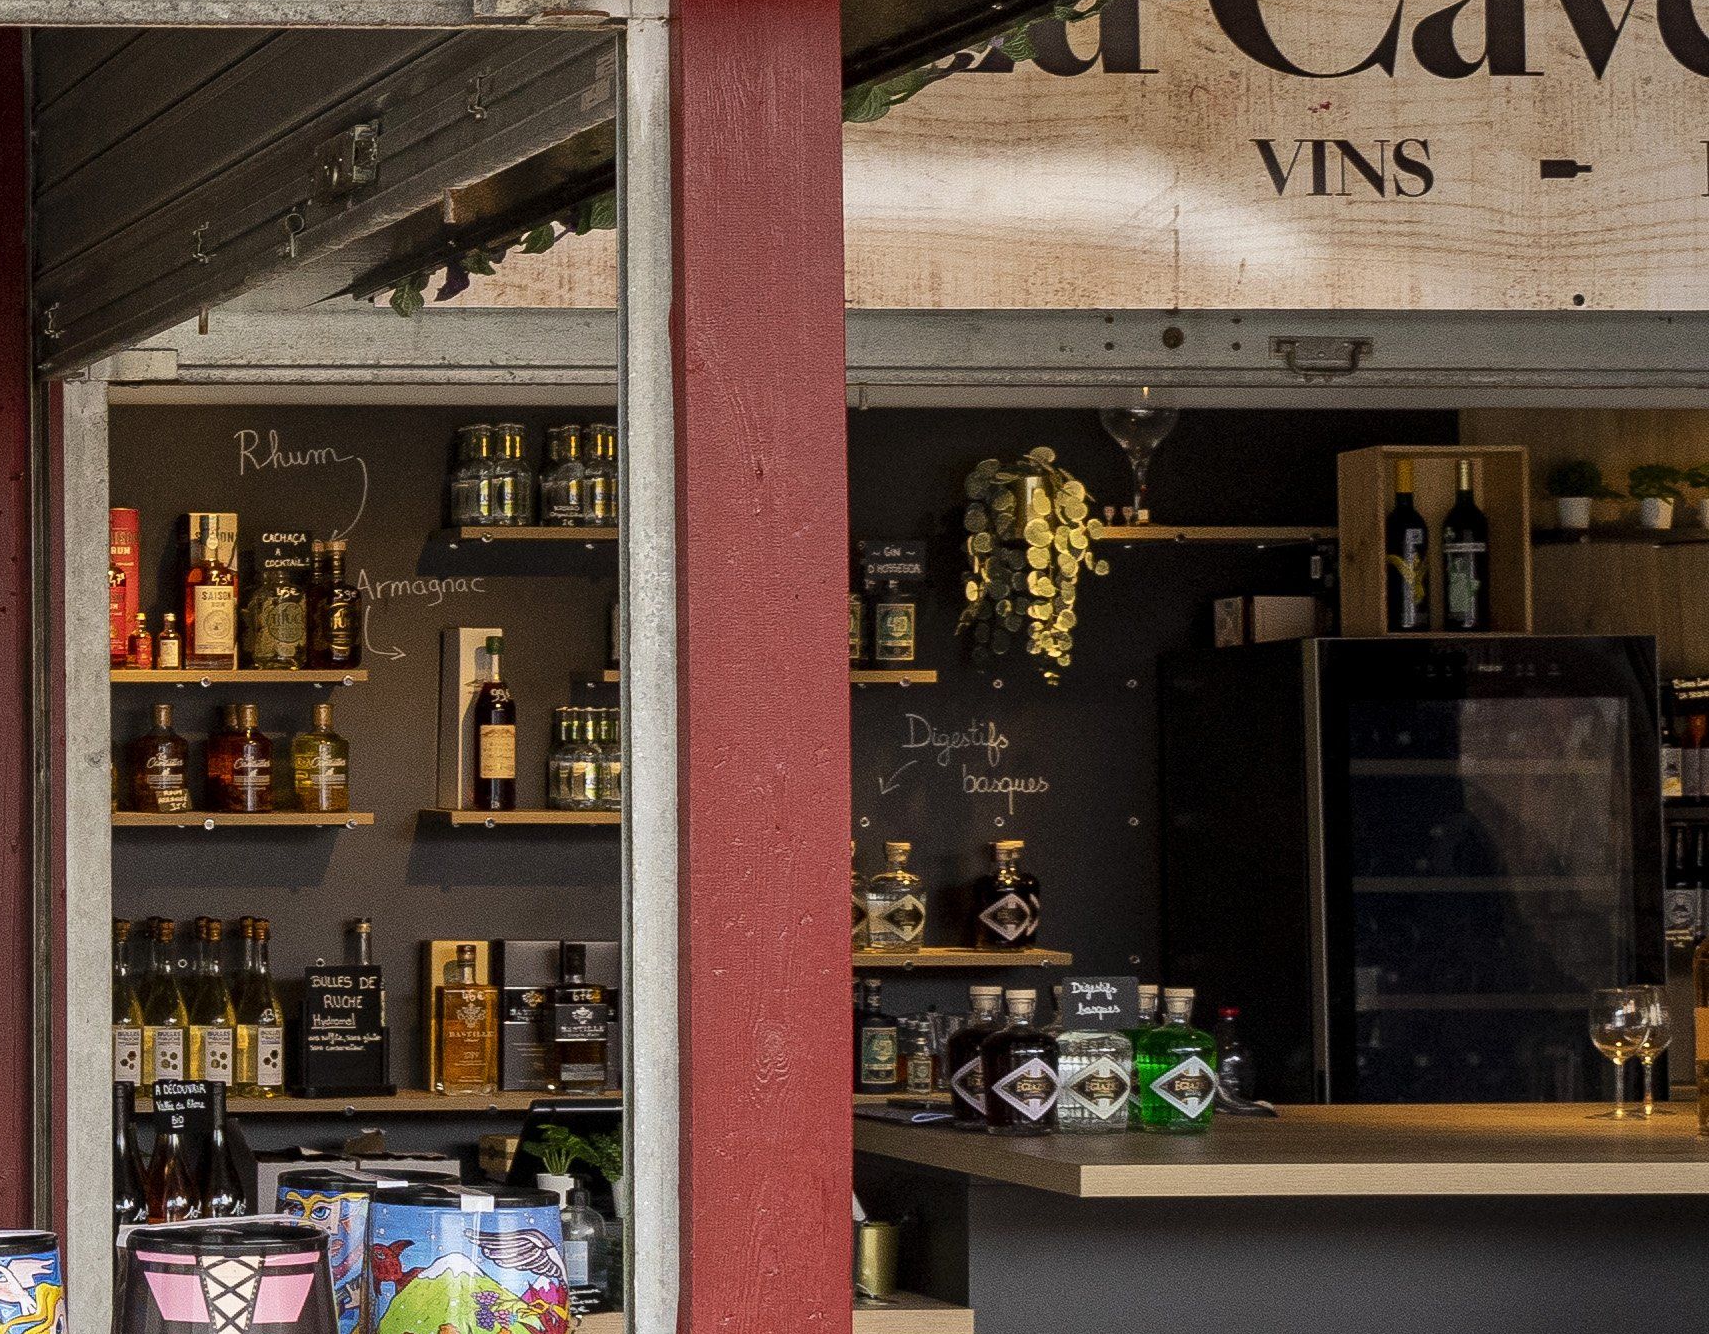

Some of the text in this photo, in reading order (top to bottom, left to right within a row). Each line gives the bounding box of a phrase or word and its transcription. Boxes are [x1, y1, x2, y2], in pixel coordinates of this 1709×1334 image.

[1249, 137, 1435, 199] VINS
[234, 428, 355, 475] Rhum
[262, 533, 307, 546] CACHAÇA
[356, 568, 487, 607] Armagnac
[961, 763, 1052, 816] basques
[311, 975, 377, 990] BULLES DE
[323, 995, 363, 1009] RUCHE
